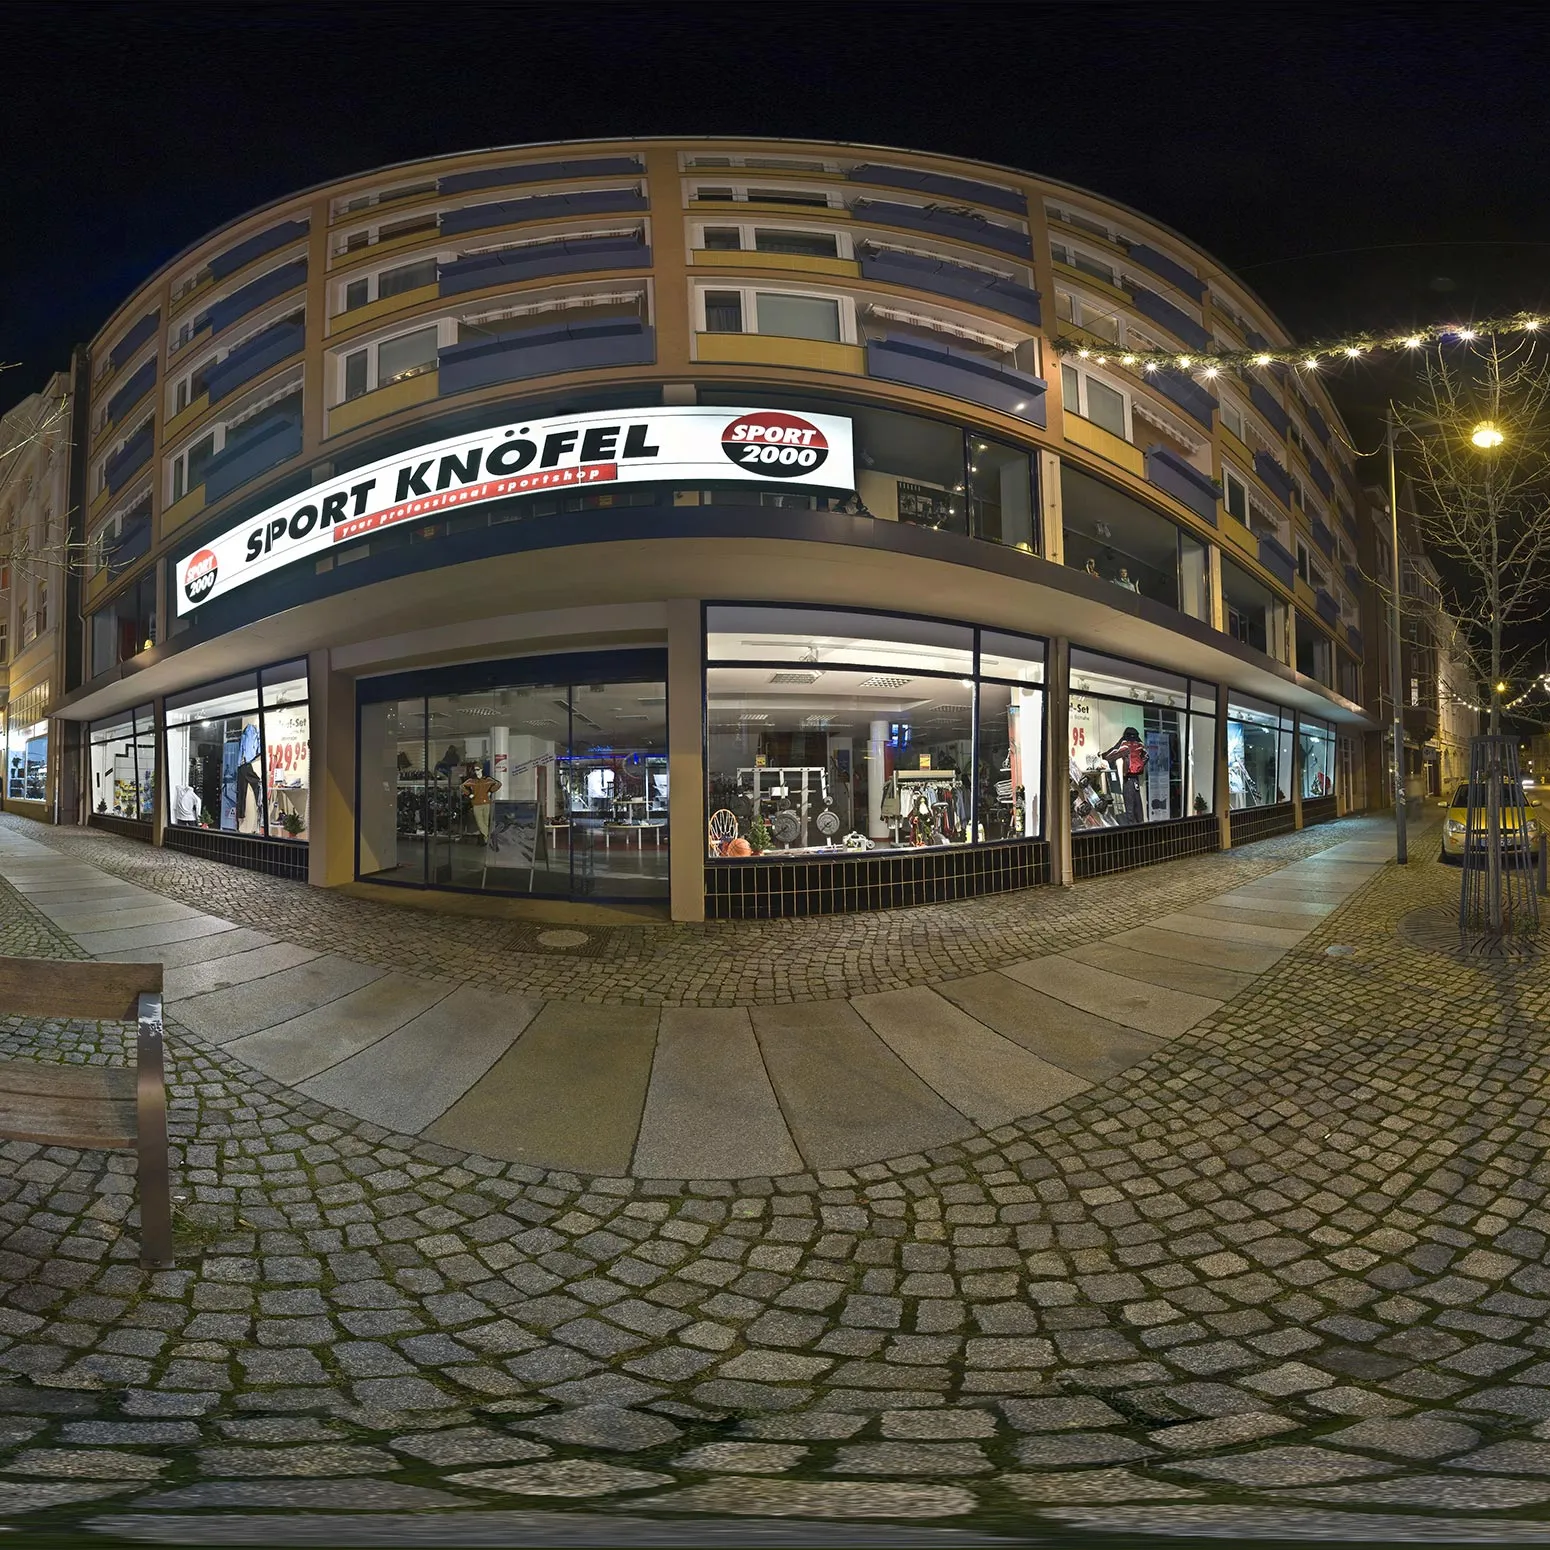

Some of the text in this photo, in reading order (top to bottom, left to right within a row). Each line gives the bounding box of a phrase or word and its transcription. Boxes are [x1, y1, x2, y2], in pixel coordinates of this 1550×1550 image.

[731, 424, 817, 446] SPORT
[740, 445, 818, 467] 2000
[245, 424, 660, 562] SPORT KNÖFEL
[342, 467, 600, 538] your professional sportshop
[186, 555, 215, 582] SPORT
[189, 571, 216, 598] 2000
